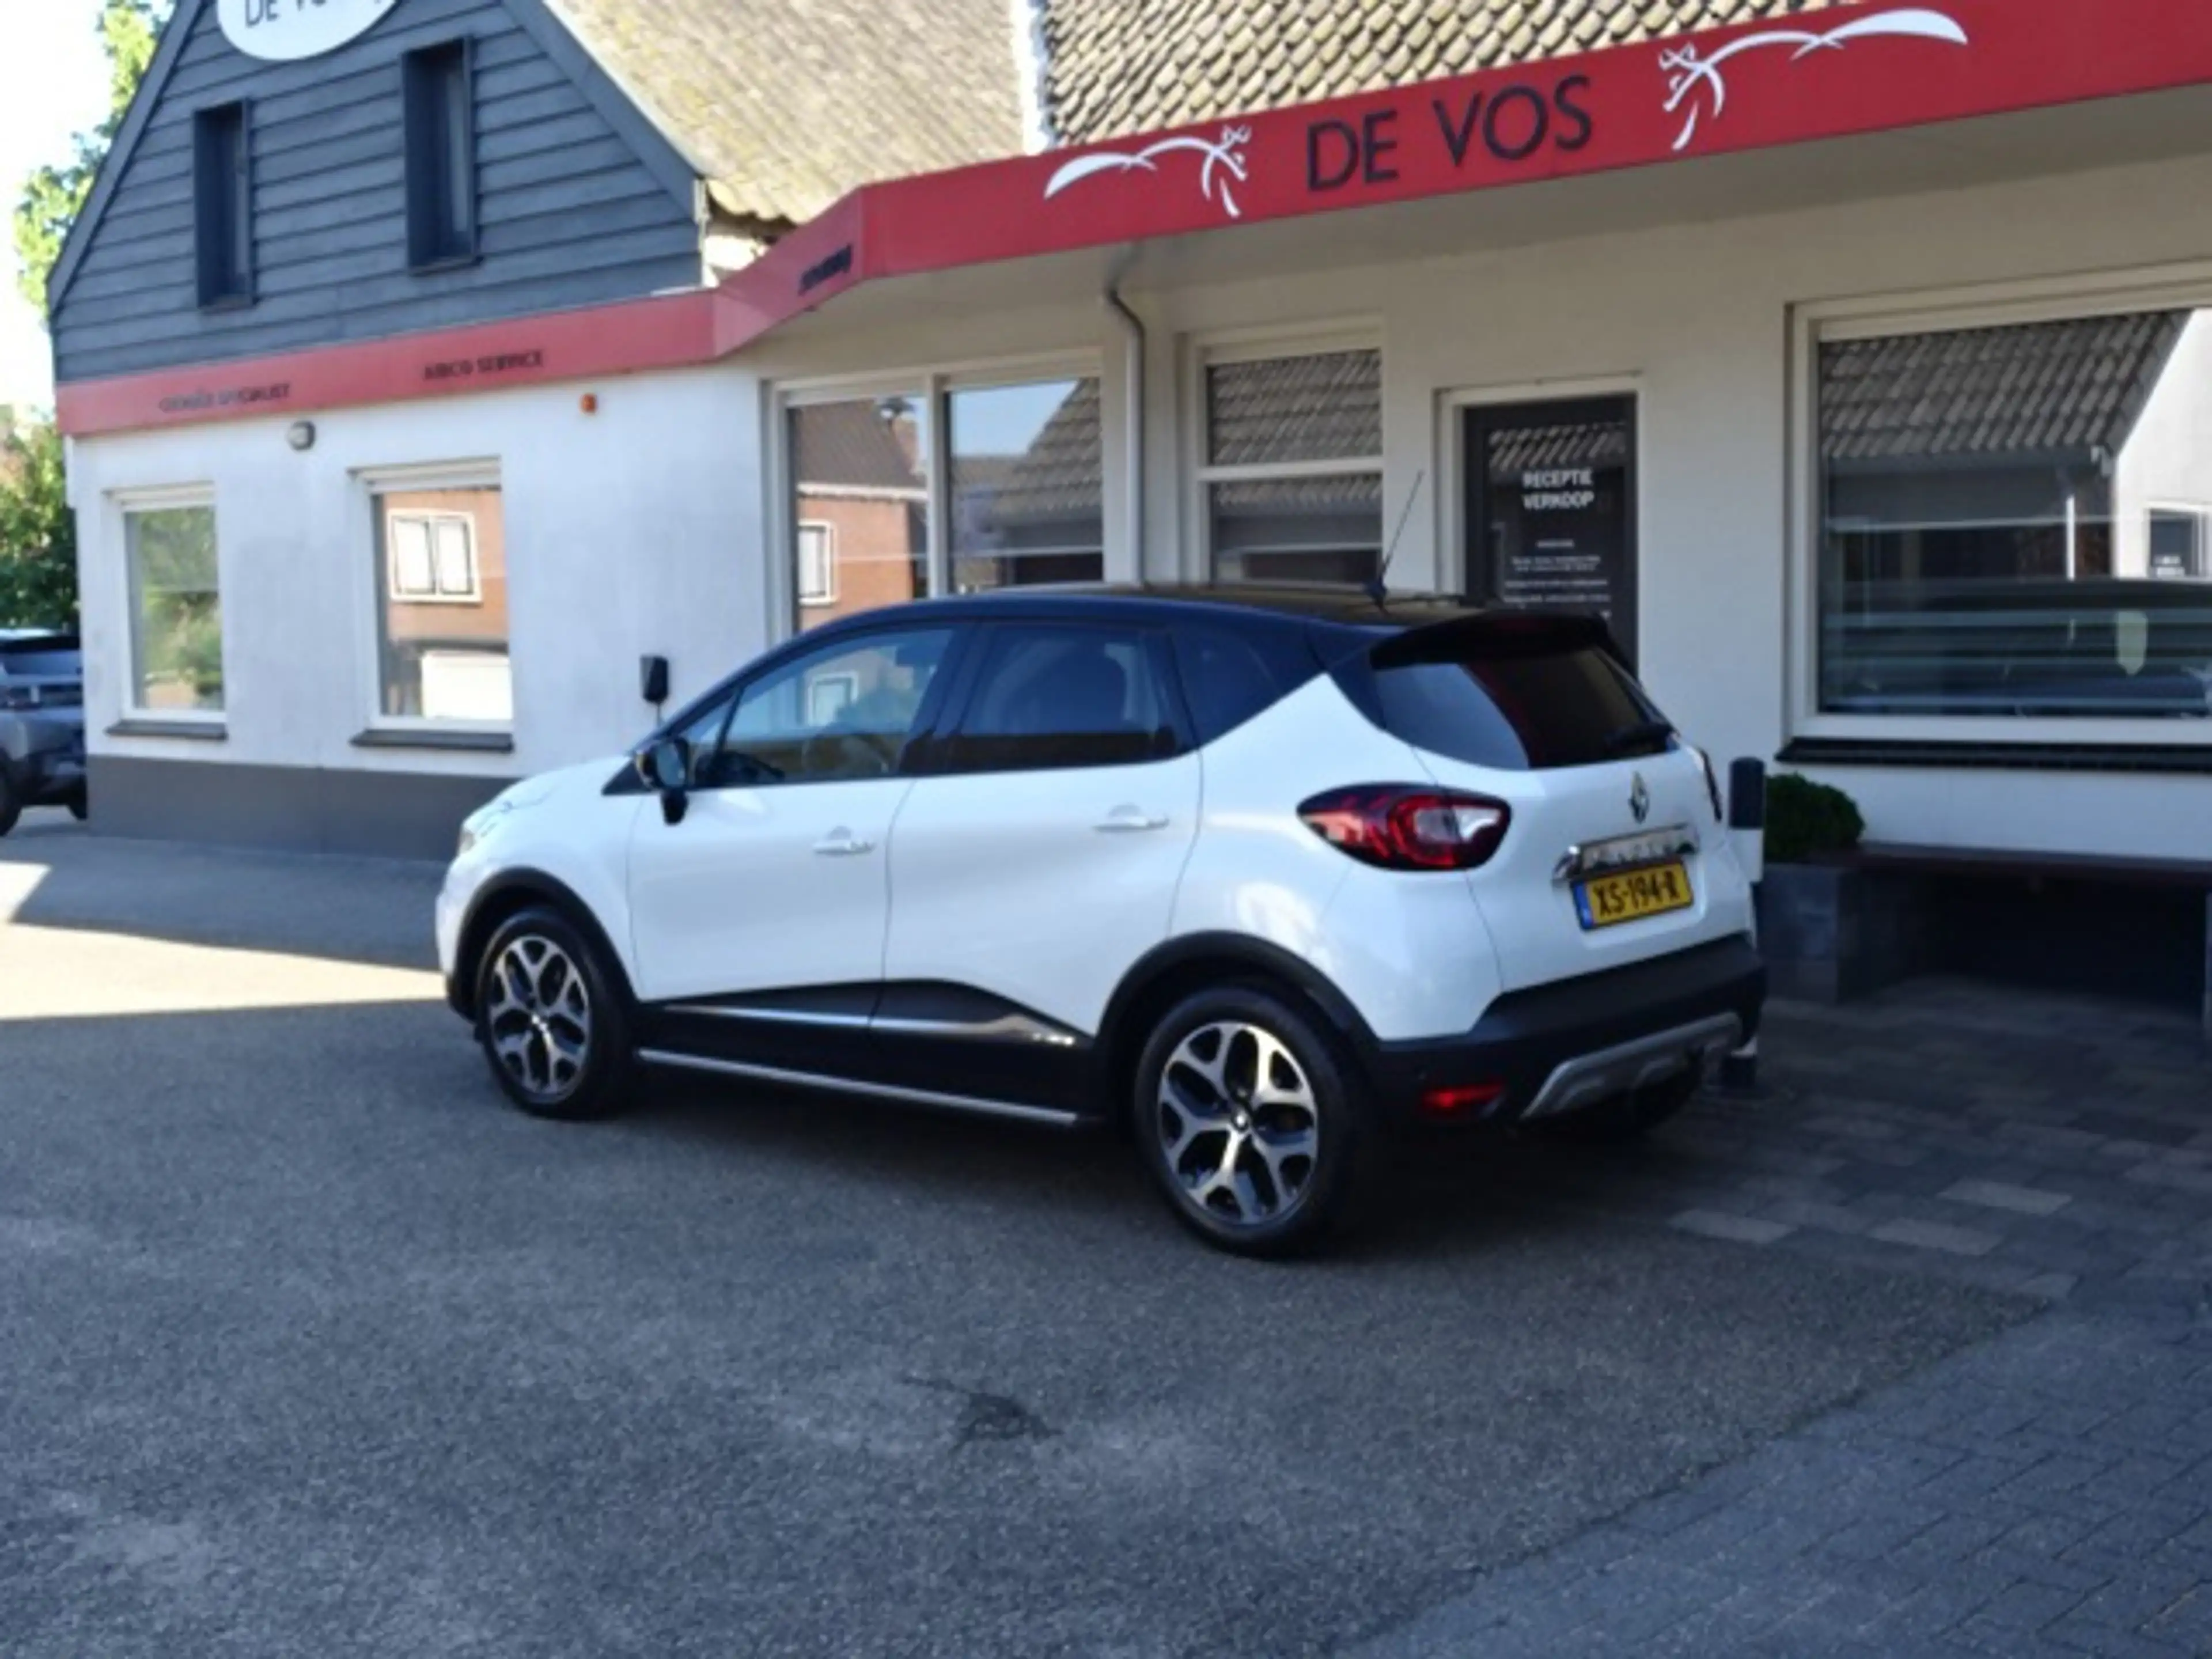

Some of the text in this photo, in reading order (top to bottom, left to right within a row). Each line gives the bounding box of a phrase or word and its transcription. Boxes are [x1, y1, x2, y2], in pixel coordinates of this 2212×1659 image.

[1306, 74, 1593, 192] DE VOS
[478, 350, 542, 372] SERVICE
[1522, 468, 1593, 488] RECEPTIE
[1522, 491, 1595, 510] VERKOOP
